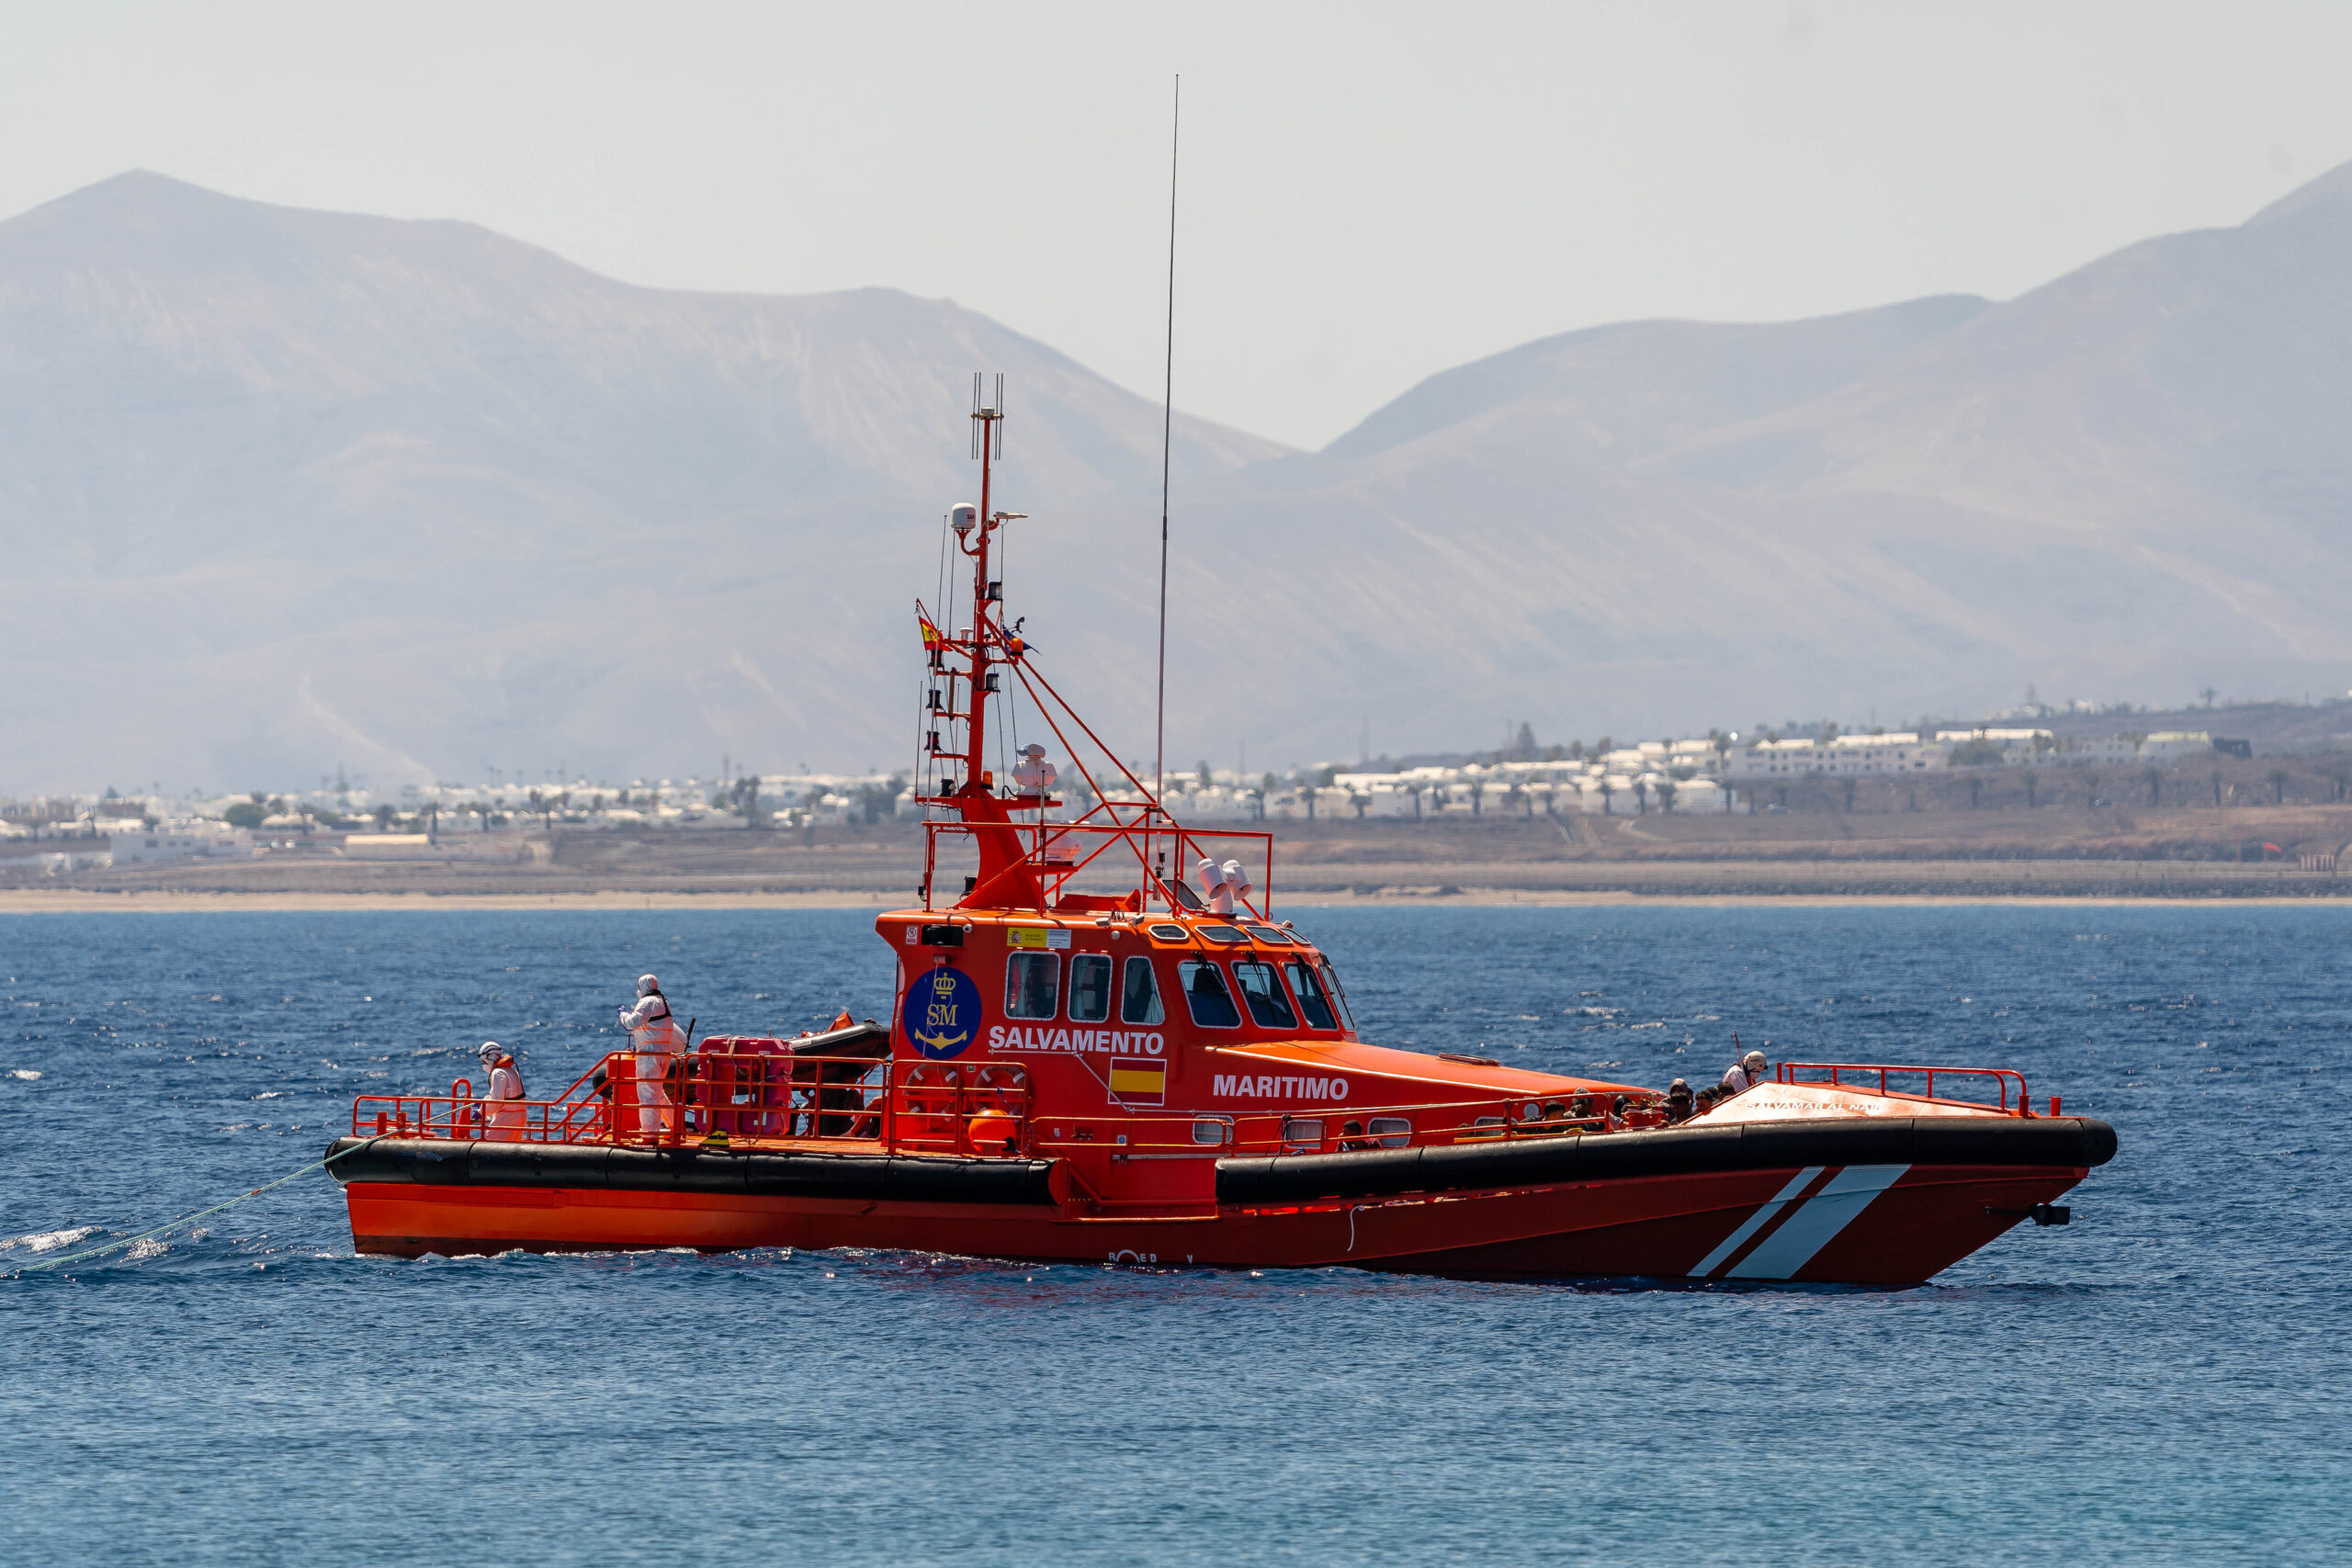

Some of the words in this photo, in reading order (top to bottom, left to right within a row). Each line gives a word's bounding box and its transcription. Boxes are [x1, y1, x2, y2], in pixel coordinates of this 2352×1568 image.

[925, 1003, 959, 1027] SM
[989, 1025, 1164, 1055] SALVAMENTO
[1213, 1074, 1349, 1100] MARITIMO
